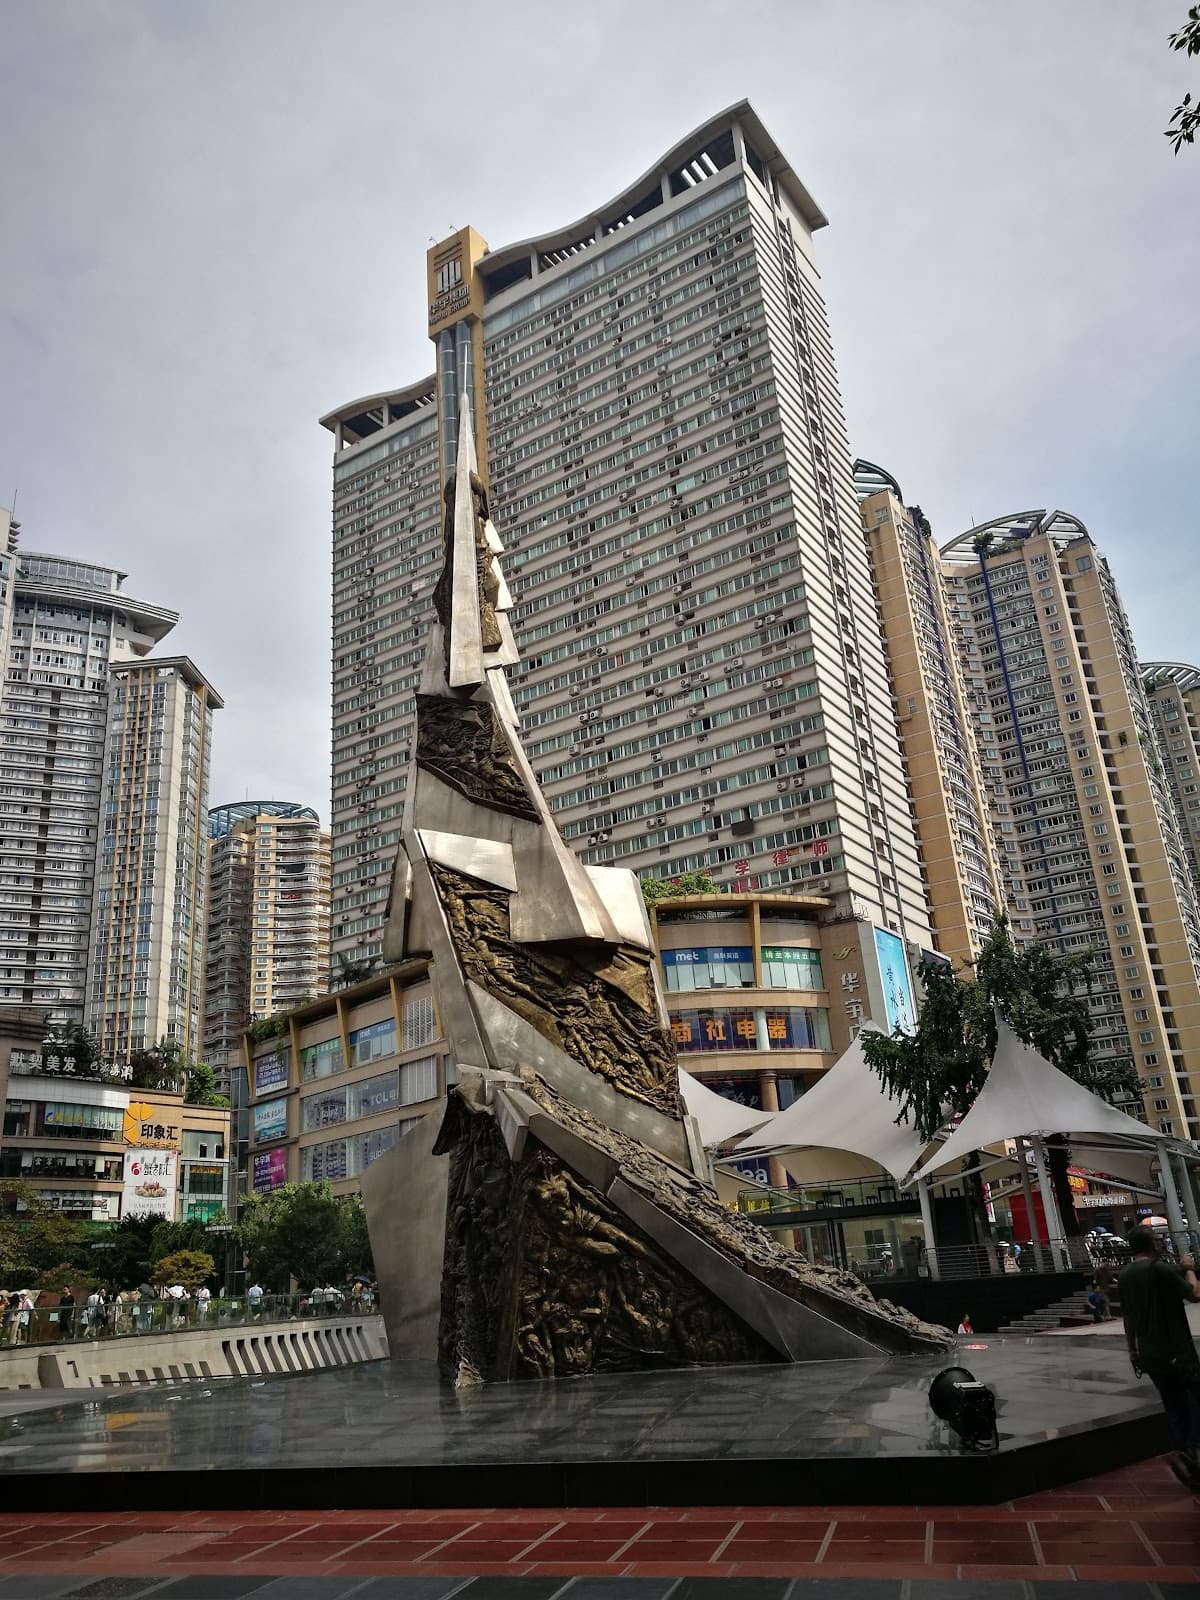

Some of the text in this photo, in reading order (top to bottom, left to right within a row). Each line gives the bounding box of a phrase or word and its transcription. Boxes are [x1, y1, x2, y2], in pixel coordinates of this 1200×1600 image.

[676, 951, 700, 961] met
[671, 1018, 787, 1043] 商社电器
[9, 1052, 77, 1073] 默契美发
[140, 1123, 179, 1141] 印象汇
